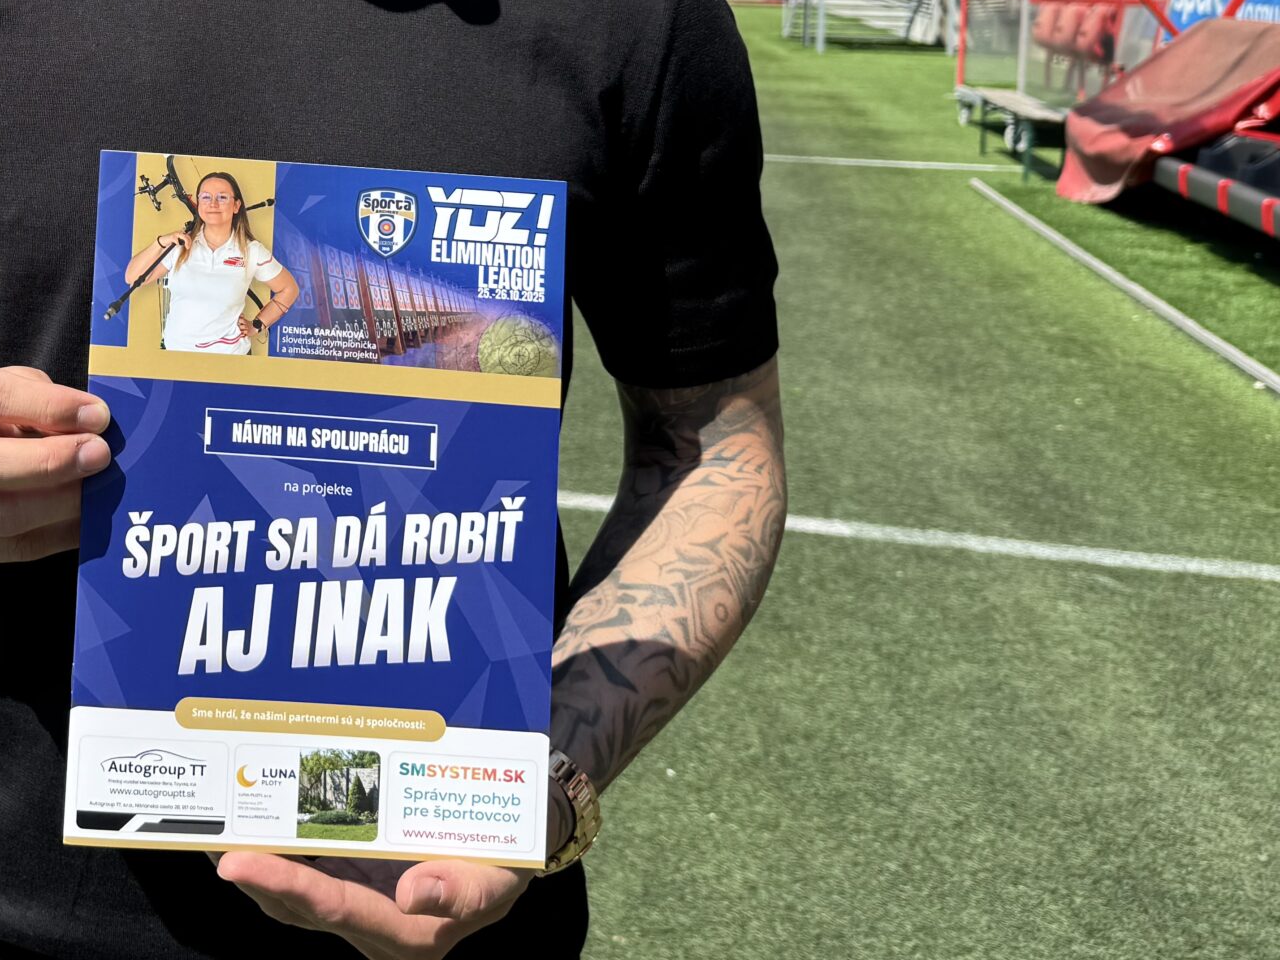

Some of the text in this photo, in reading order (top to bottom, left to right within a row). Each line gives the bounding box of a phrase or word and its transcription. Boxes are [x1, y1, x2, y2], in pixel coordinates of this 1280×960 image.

[431, 239, 546, 270] ELIMINATION
[478, 265, 546, 292] LEAGUE
[477, 287, 545, 303] 25.-26.10.2025
[282, 326, 312, 335] DENISA
[282, 335, 377, 350] slovenská olympionička
[288, 345, 342, 357] ambasádorka
[344, 350, 378, 361] projektu
[232, 419, 410, 455] NÁVRH NA SPOLUPRÁCU
[284, 482, 353, 497] na projekte
[122, 496, 526, 579] ŠPORT SA DÁ ROBIŤ
[177, 576, 458, 676] AJ INAK
[191, 708, 426, 732] Sme hrdí, že našimi partnermi sú aj spoločnosti:
[108, 760, 207, 780] Autogroup TT
[262, 768, 297, 779] LUNA
[399, 762, 526, 783] SMSYSTEM.SK
[109, 787, 196, 799] www.autogrouptt.sk
[403, 787, 521, 809] Správny pohyb
[403, 805, 521, 823] pre športovcov
[402, 828, 517, 844] www.smsystem.sk
